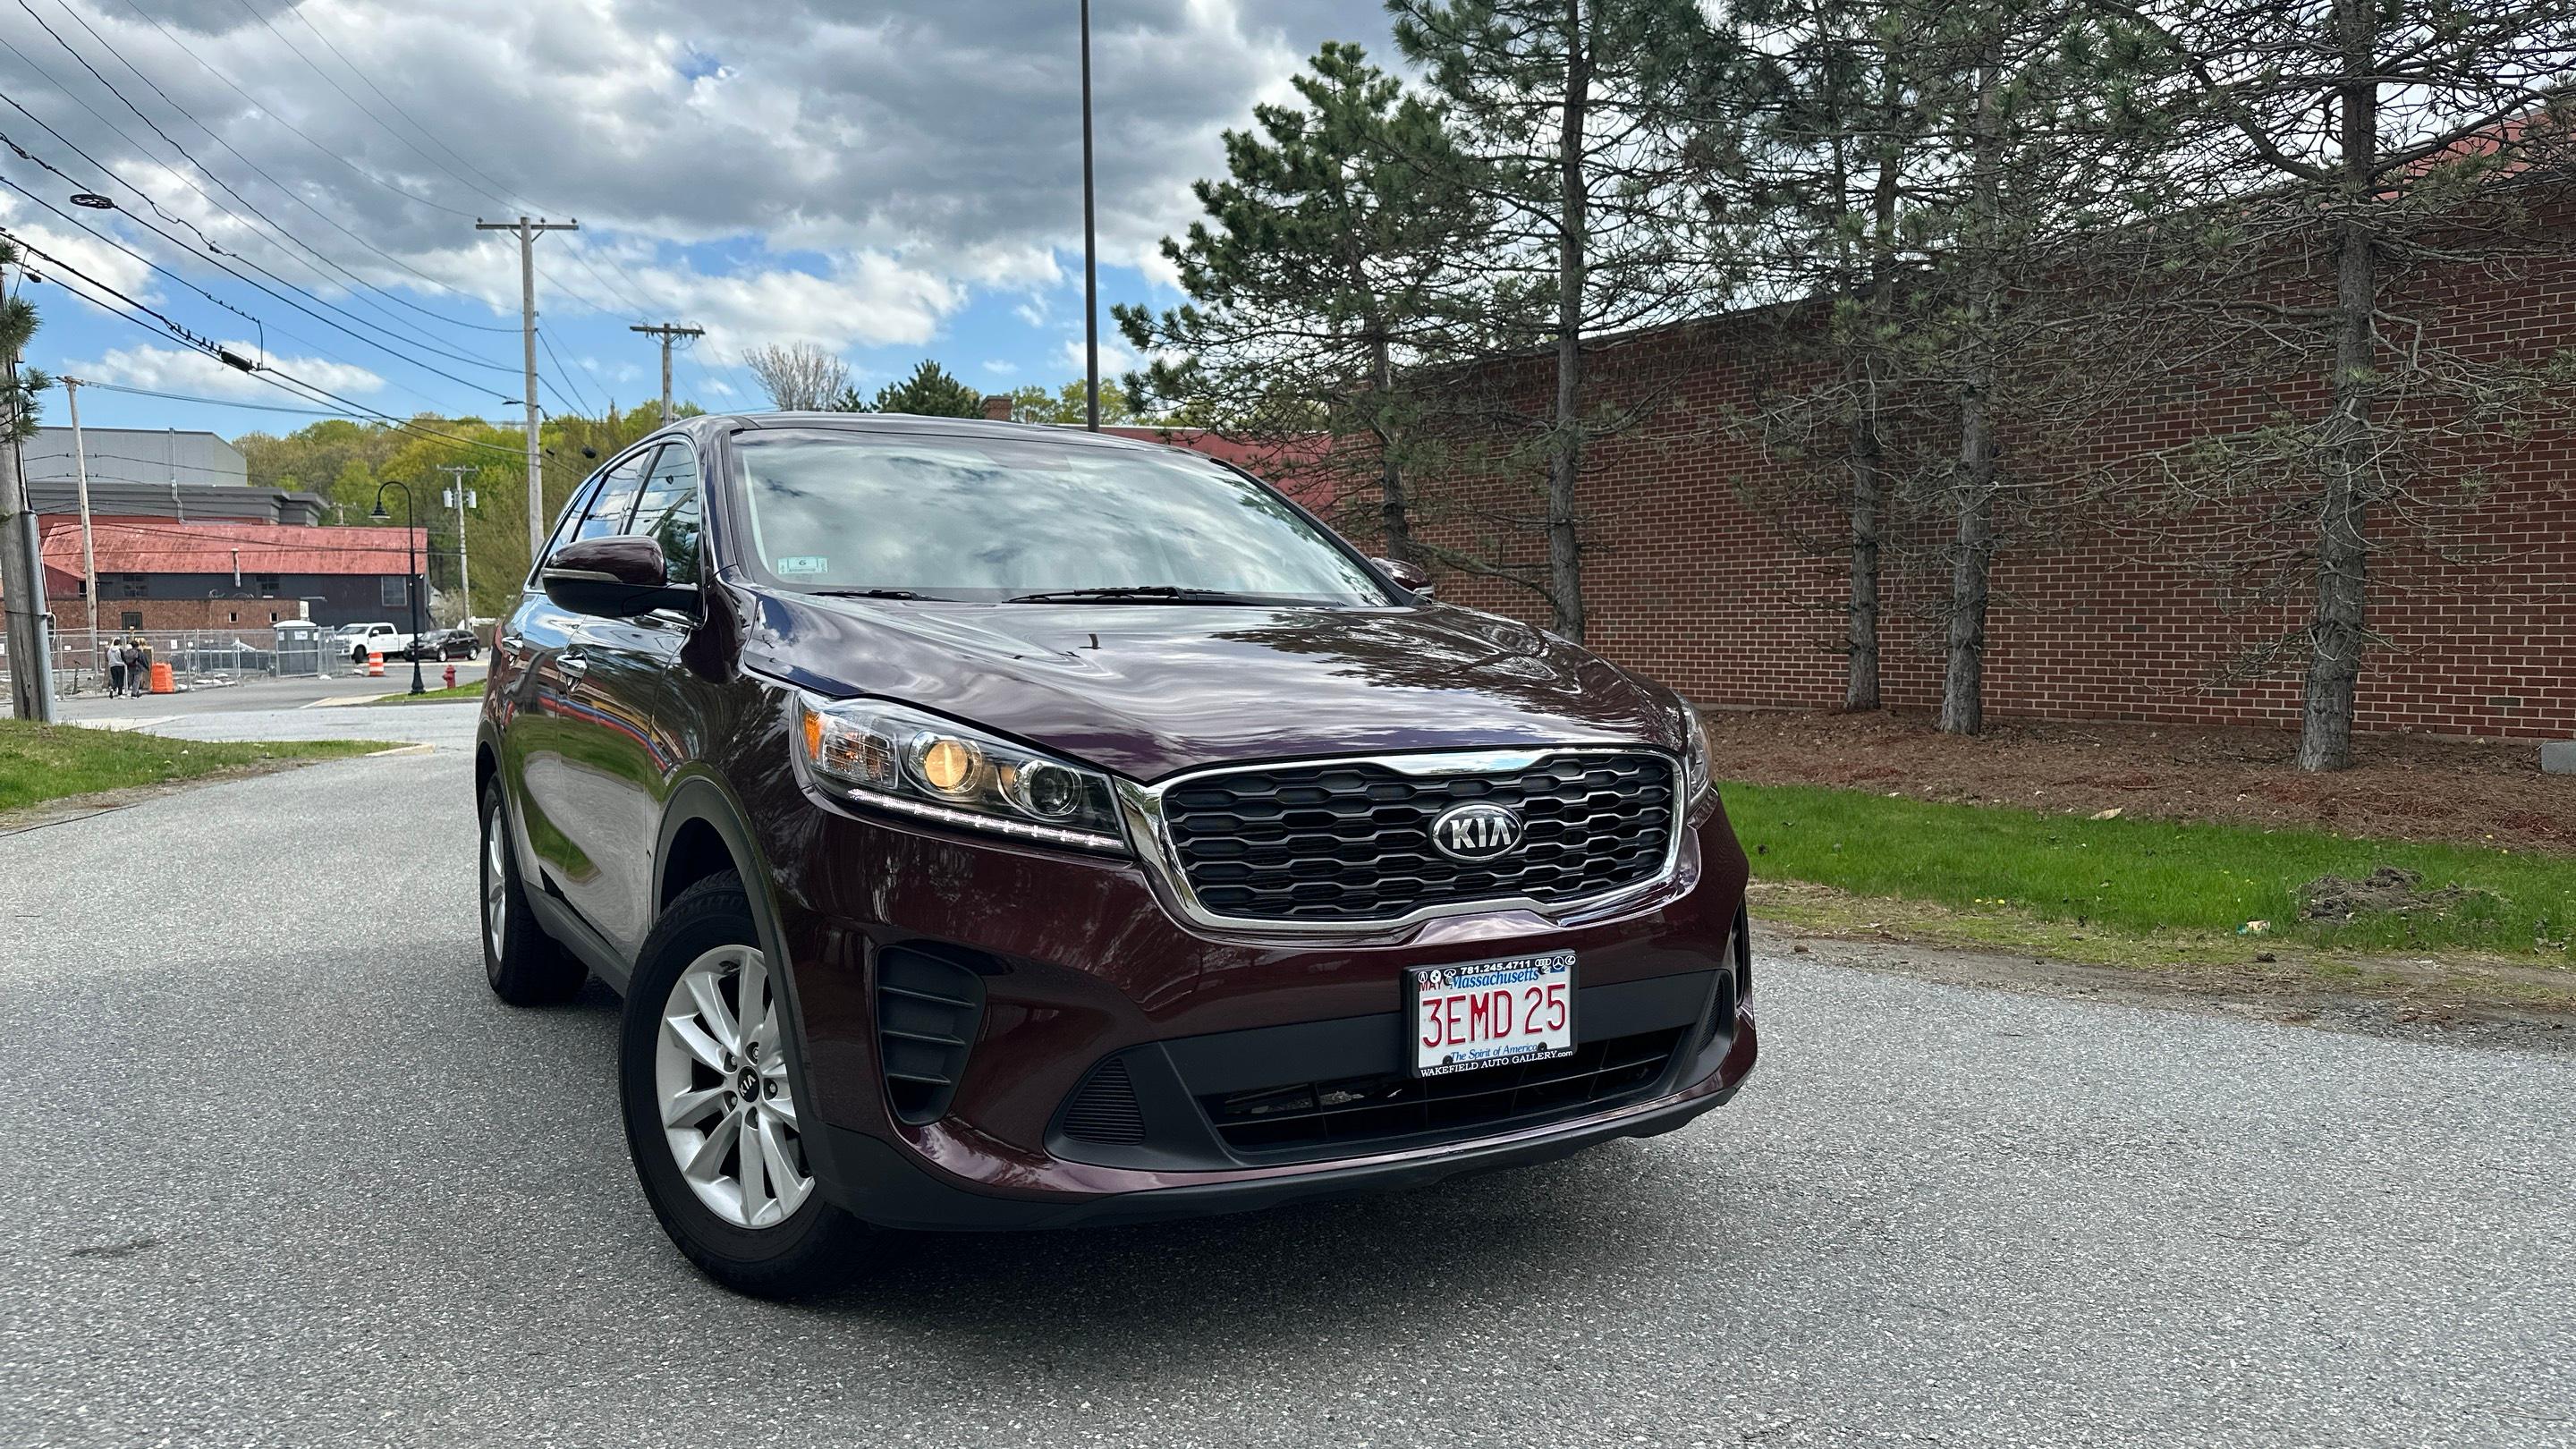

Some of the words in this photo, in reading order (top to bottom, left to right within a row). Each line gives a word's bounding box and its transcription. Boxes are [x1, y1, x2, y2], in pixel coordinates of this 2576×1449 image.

[1450, 817, 1512, 849] KIA
[1450, 967, 1539, 989] Massachusetts
[1461, 960, 1530, 975] 781.245.4711
[1422, 990, 1513, 1047] 3EMD
[1524, 984, 1566, 1035] 25
[1420, 1062, 1479, 1077] WAKEFIELD
[1480, 1057, 1509, 1069] AUTO
[1512, 1050, 1573, 1063] GALLERY.com
[1450, 1051, 1466, 1062] The
[1469, 1048, 1490, 1060] Spirit
[1493, 1046, 1502, 1057] of
[1503, 1043, 1538, 1055] America
[739, 1074, 756, 1097] KIA
